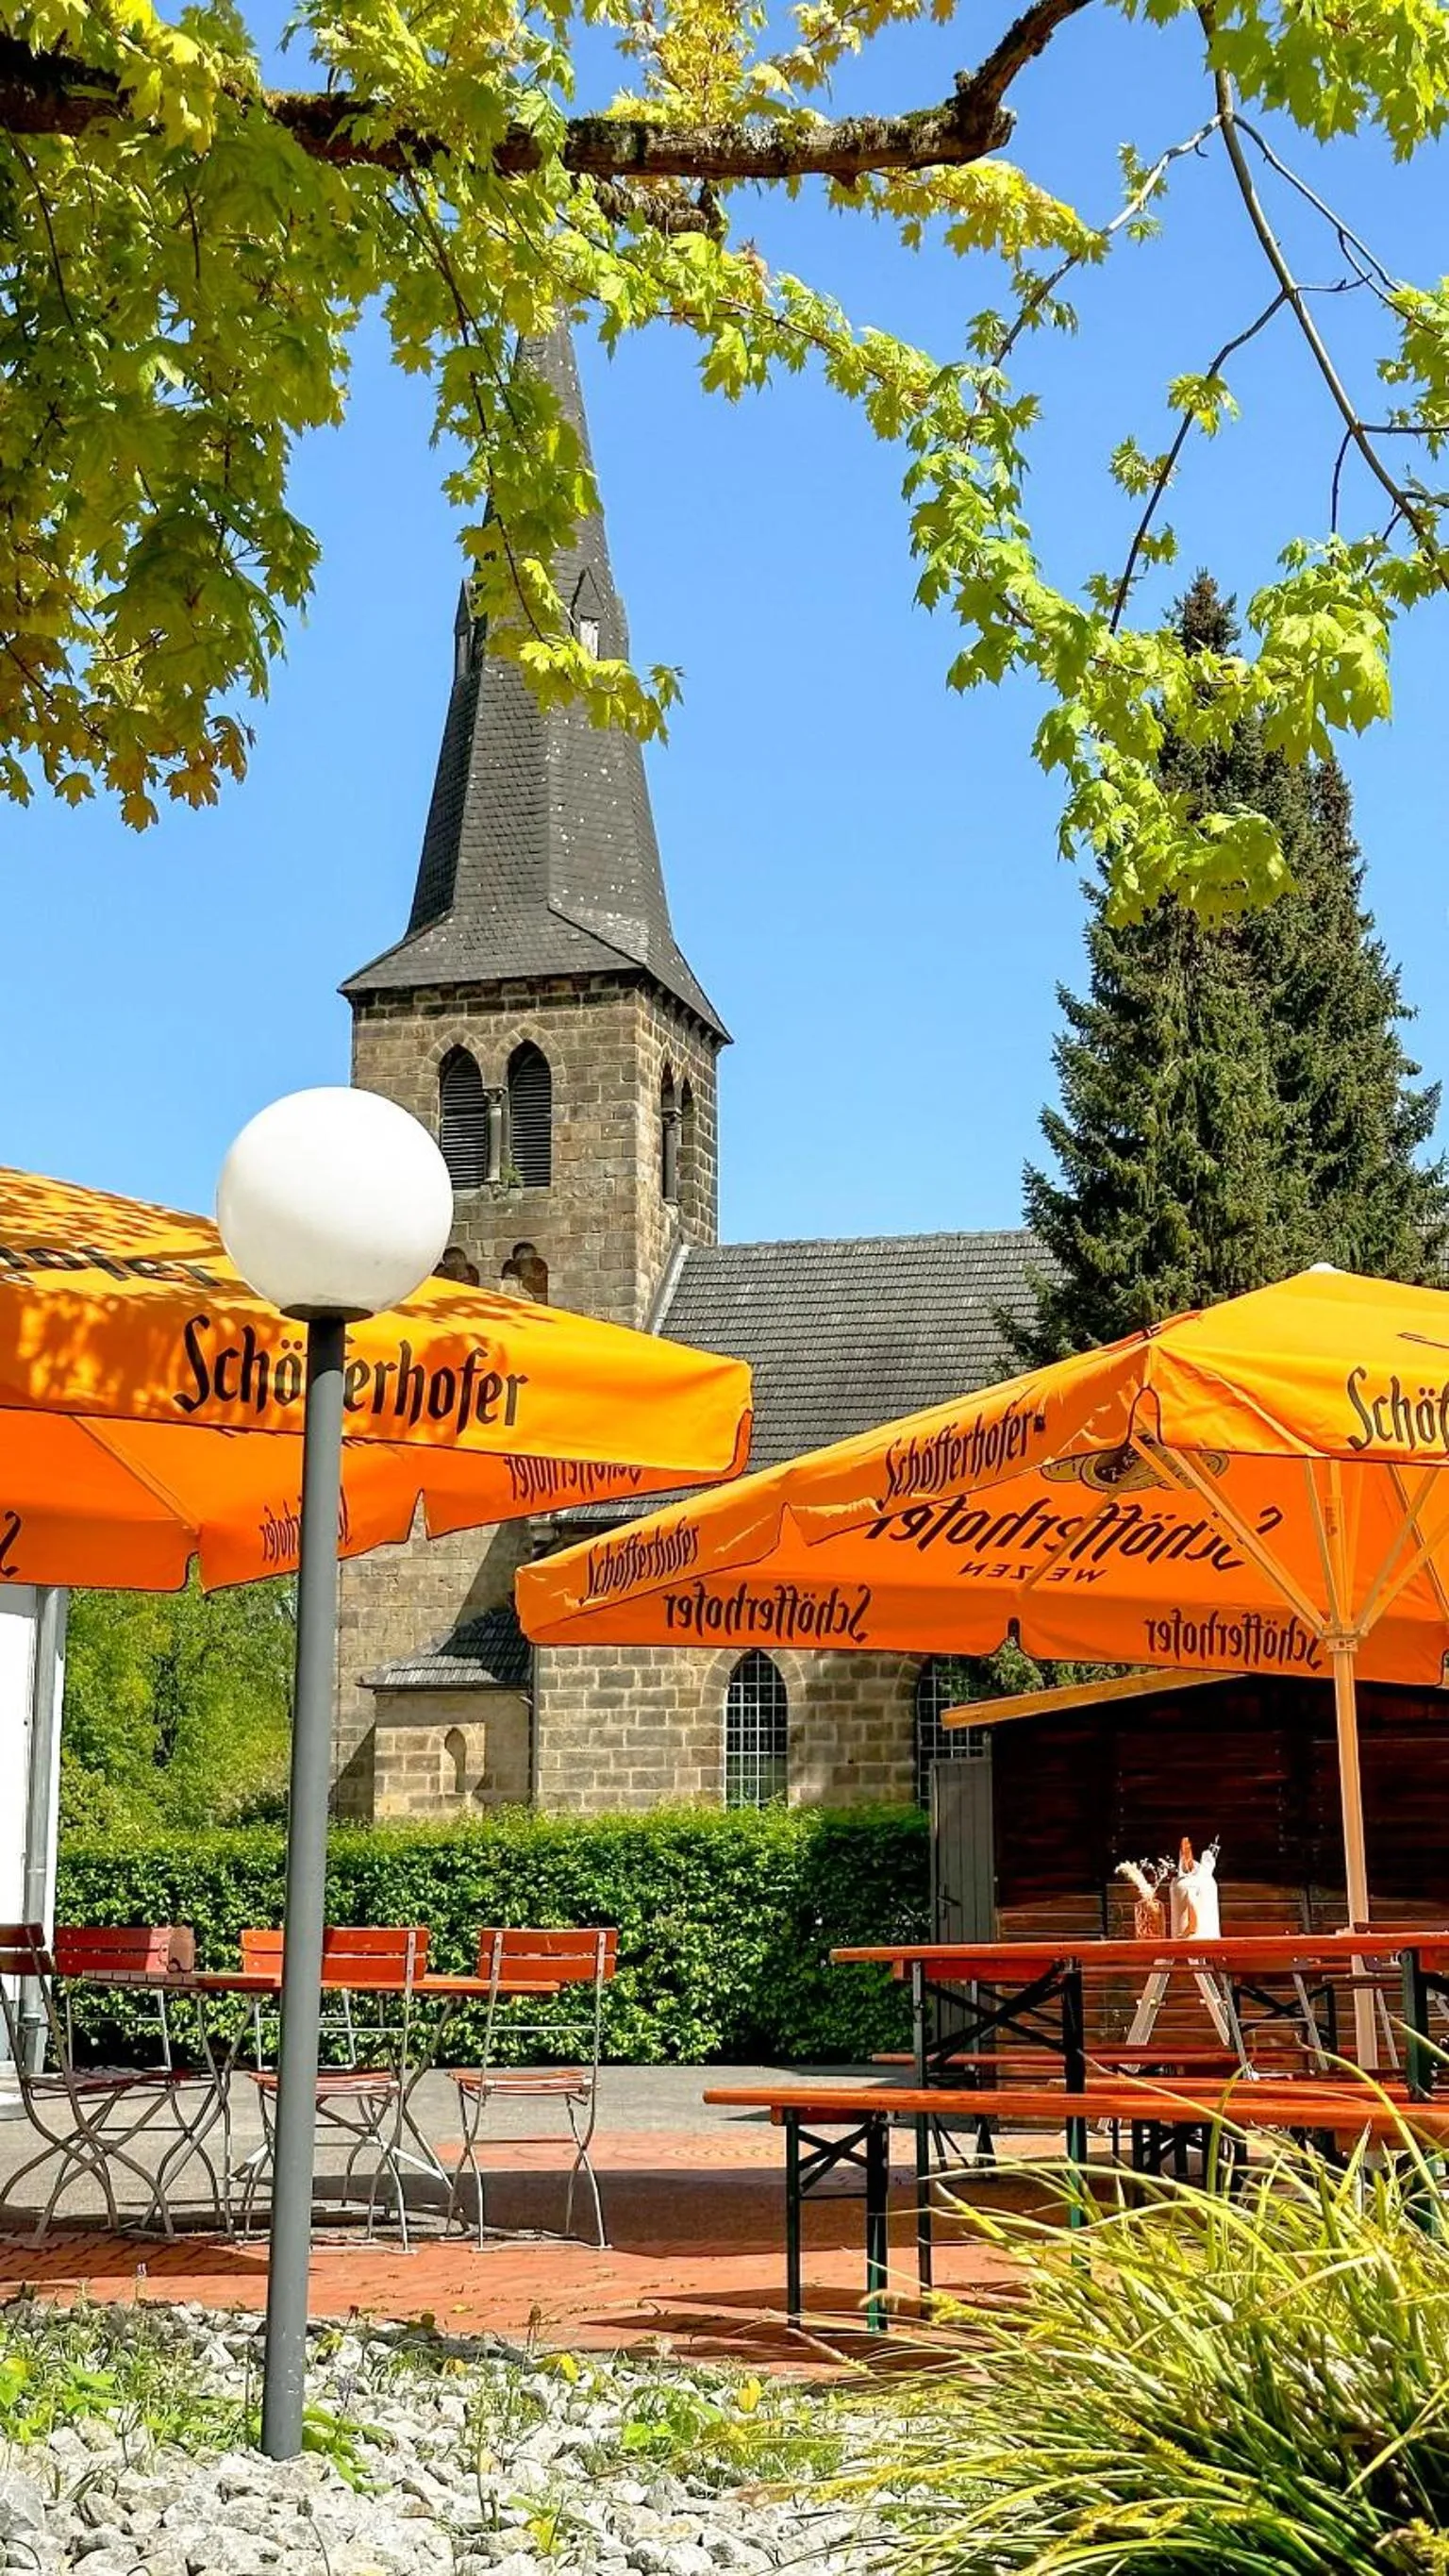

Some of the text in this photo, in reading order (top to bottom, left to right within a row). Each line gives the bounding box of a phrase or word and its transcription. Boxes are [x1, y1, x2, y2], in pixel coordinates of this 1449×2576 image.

[174, 1313, 529, 1435] Schöerhofer
[876, 1400, 1034, 1511] Schöfferhofer
[577, 1515, 700, 1606] Schöfferhofer
